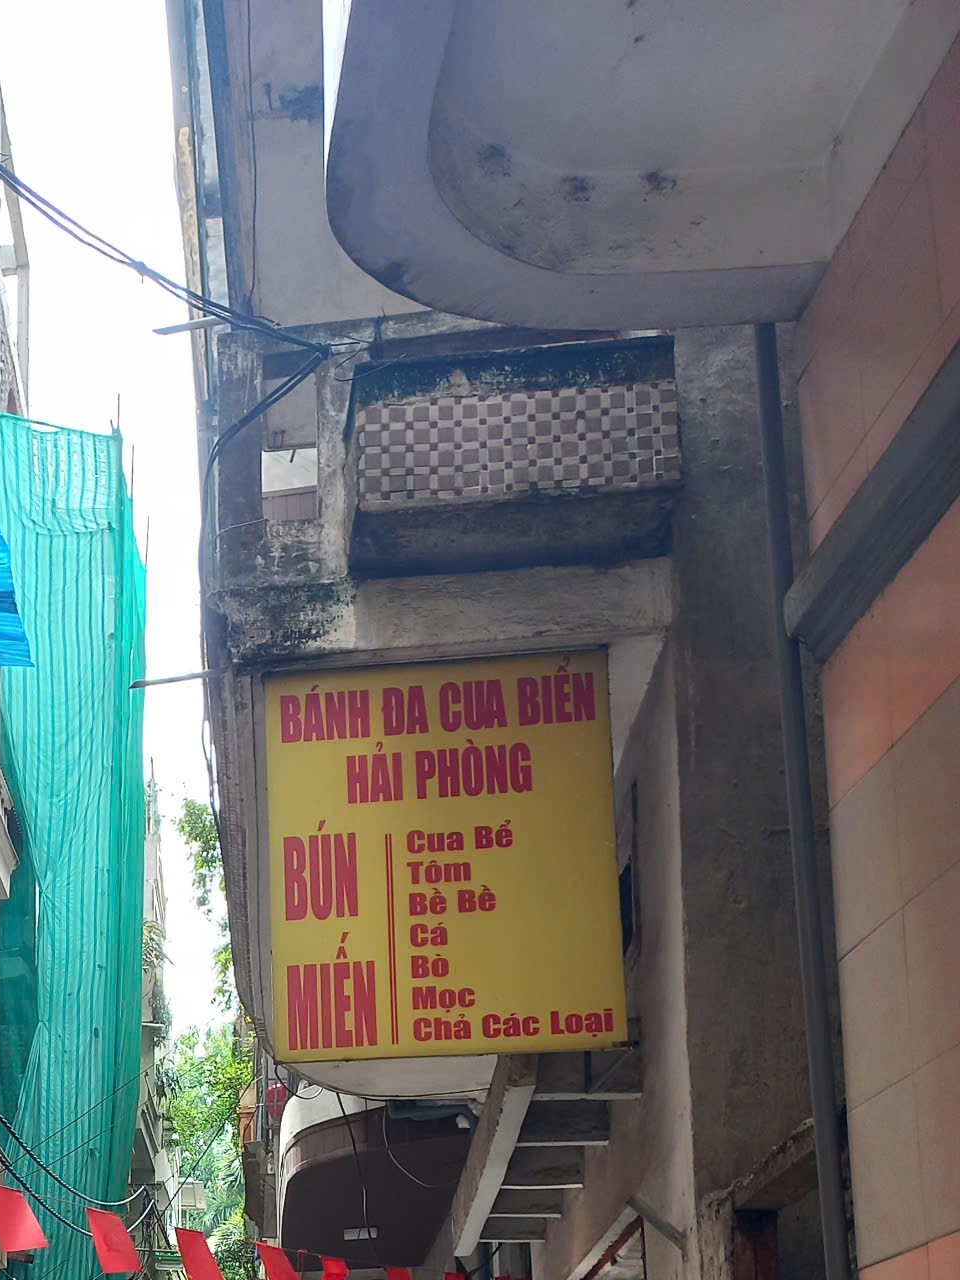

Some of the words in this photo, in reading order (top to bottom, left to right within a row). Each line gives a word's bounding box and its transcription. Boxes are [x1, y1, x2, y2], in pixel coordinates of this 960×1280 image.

[280, 685, 371, 743] BÁNH
[382, 685, 429, 736] ĐA
[439, 679, 507, 732] CUA
[517, 656, 596, 725] BIỂN
[347, 741, 403, 803] HẢI
[415, 739, 533, 799] PHÒNG
[406, 829, 465, 853] Cua
[474, 819, 513, 849] Bể
[283, 820, 359, 921] BÚN
[406, 860, 471, 884] Tôm
[408, 887, 447, 916] Bề
[457, 884, 497, 913] Bề
[409, 922, 448, 947] Cá
[411, 953, 449, 978] Bò
[286, 932, 378, 1051] MIẾN
[411, 986, 476, 1012] Mọc
[412, 1013, 472, 1042] Chả
[482, 1012, 540, 1039] Các
[550, 1008, 614, 1038] Loại
